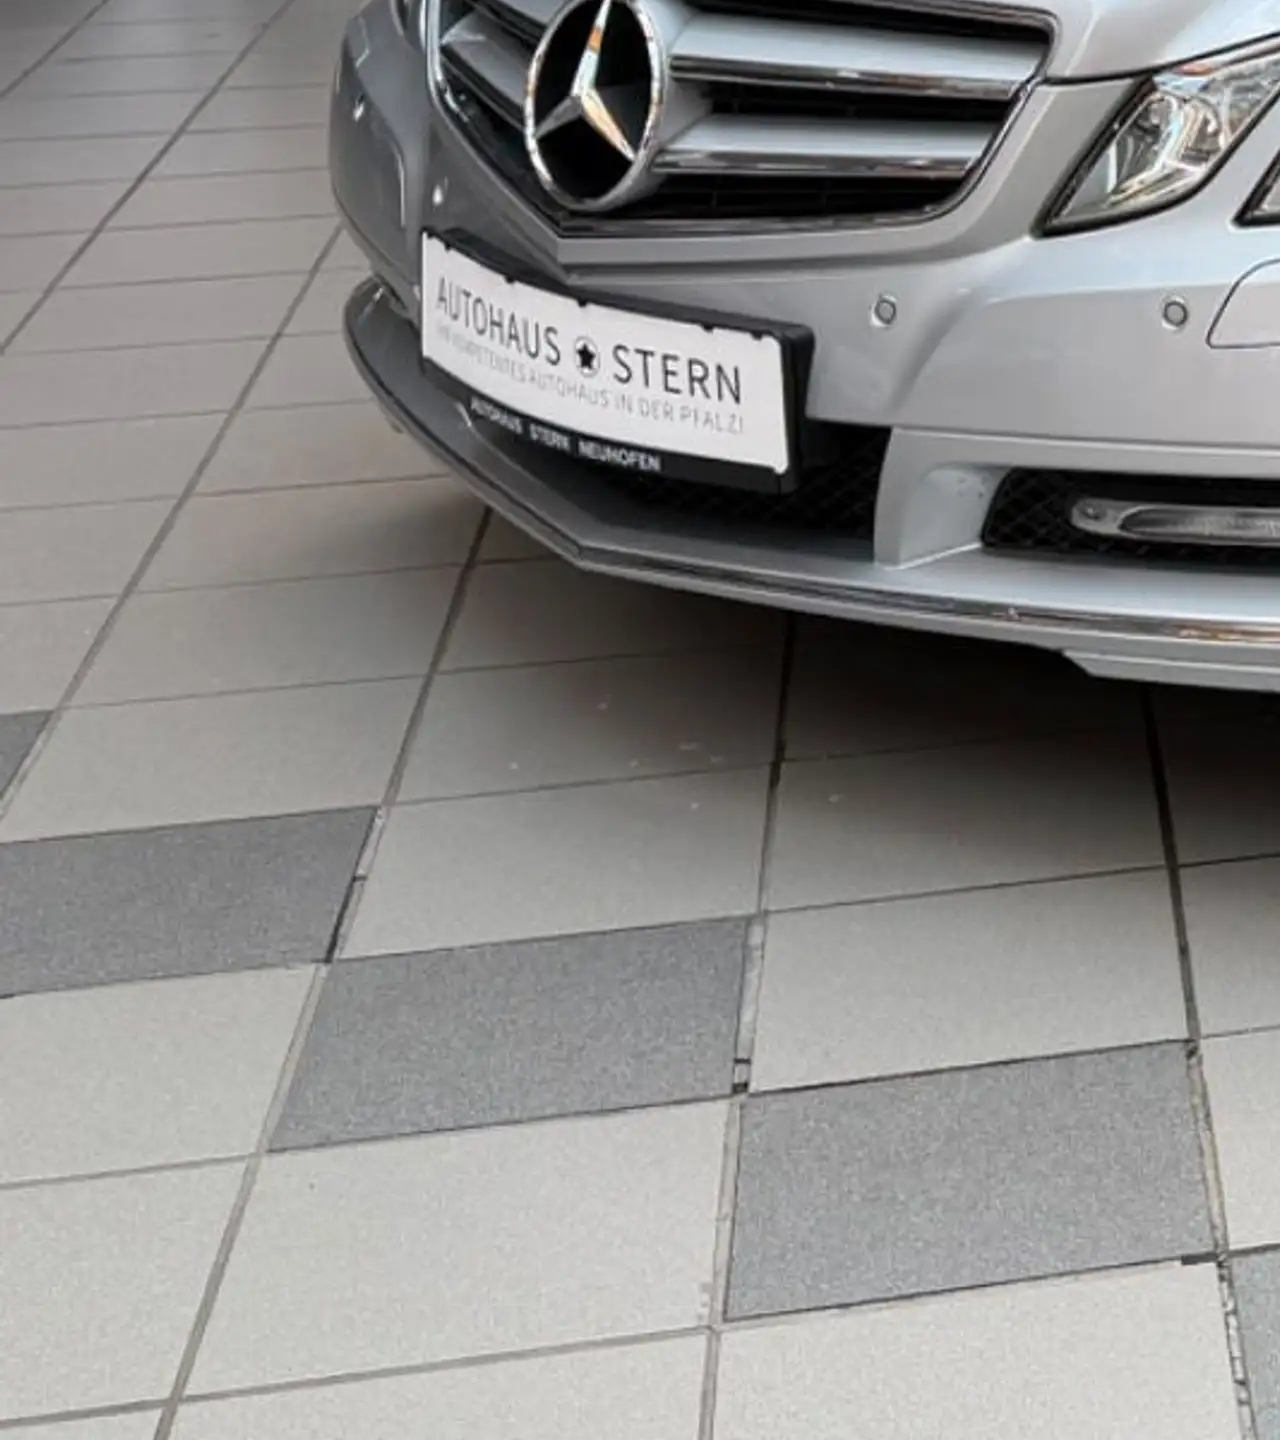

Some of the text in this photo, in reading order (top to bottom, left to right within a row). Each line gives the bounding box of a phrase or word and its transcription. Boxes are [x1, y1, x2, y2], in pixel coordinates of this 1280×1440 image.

[435, 277, 742, 405] AUTOHAUS STERN
[529, 369, 611, 408] AUTOHAUS
[638, 397, 674, 422] DER
